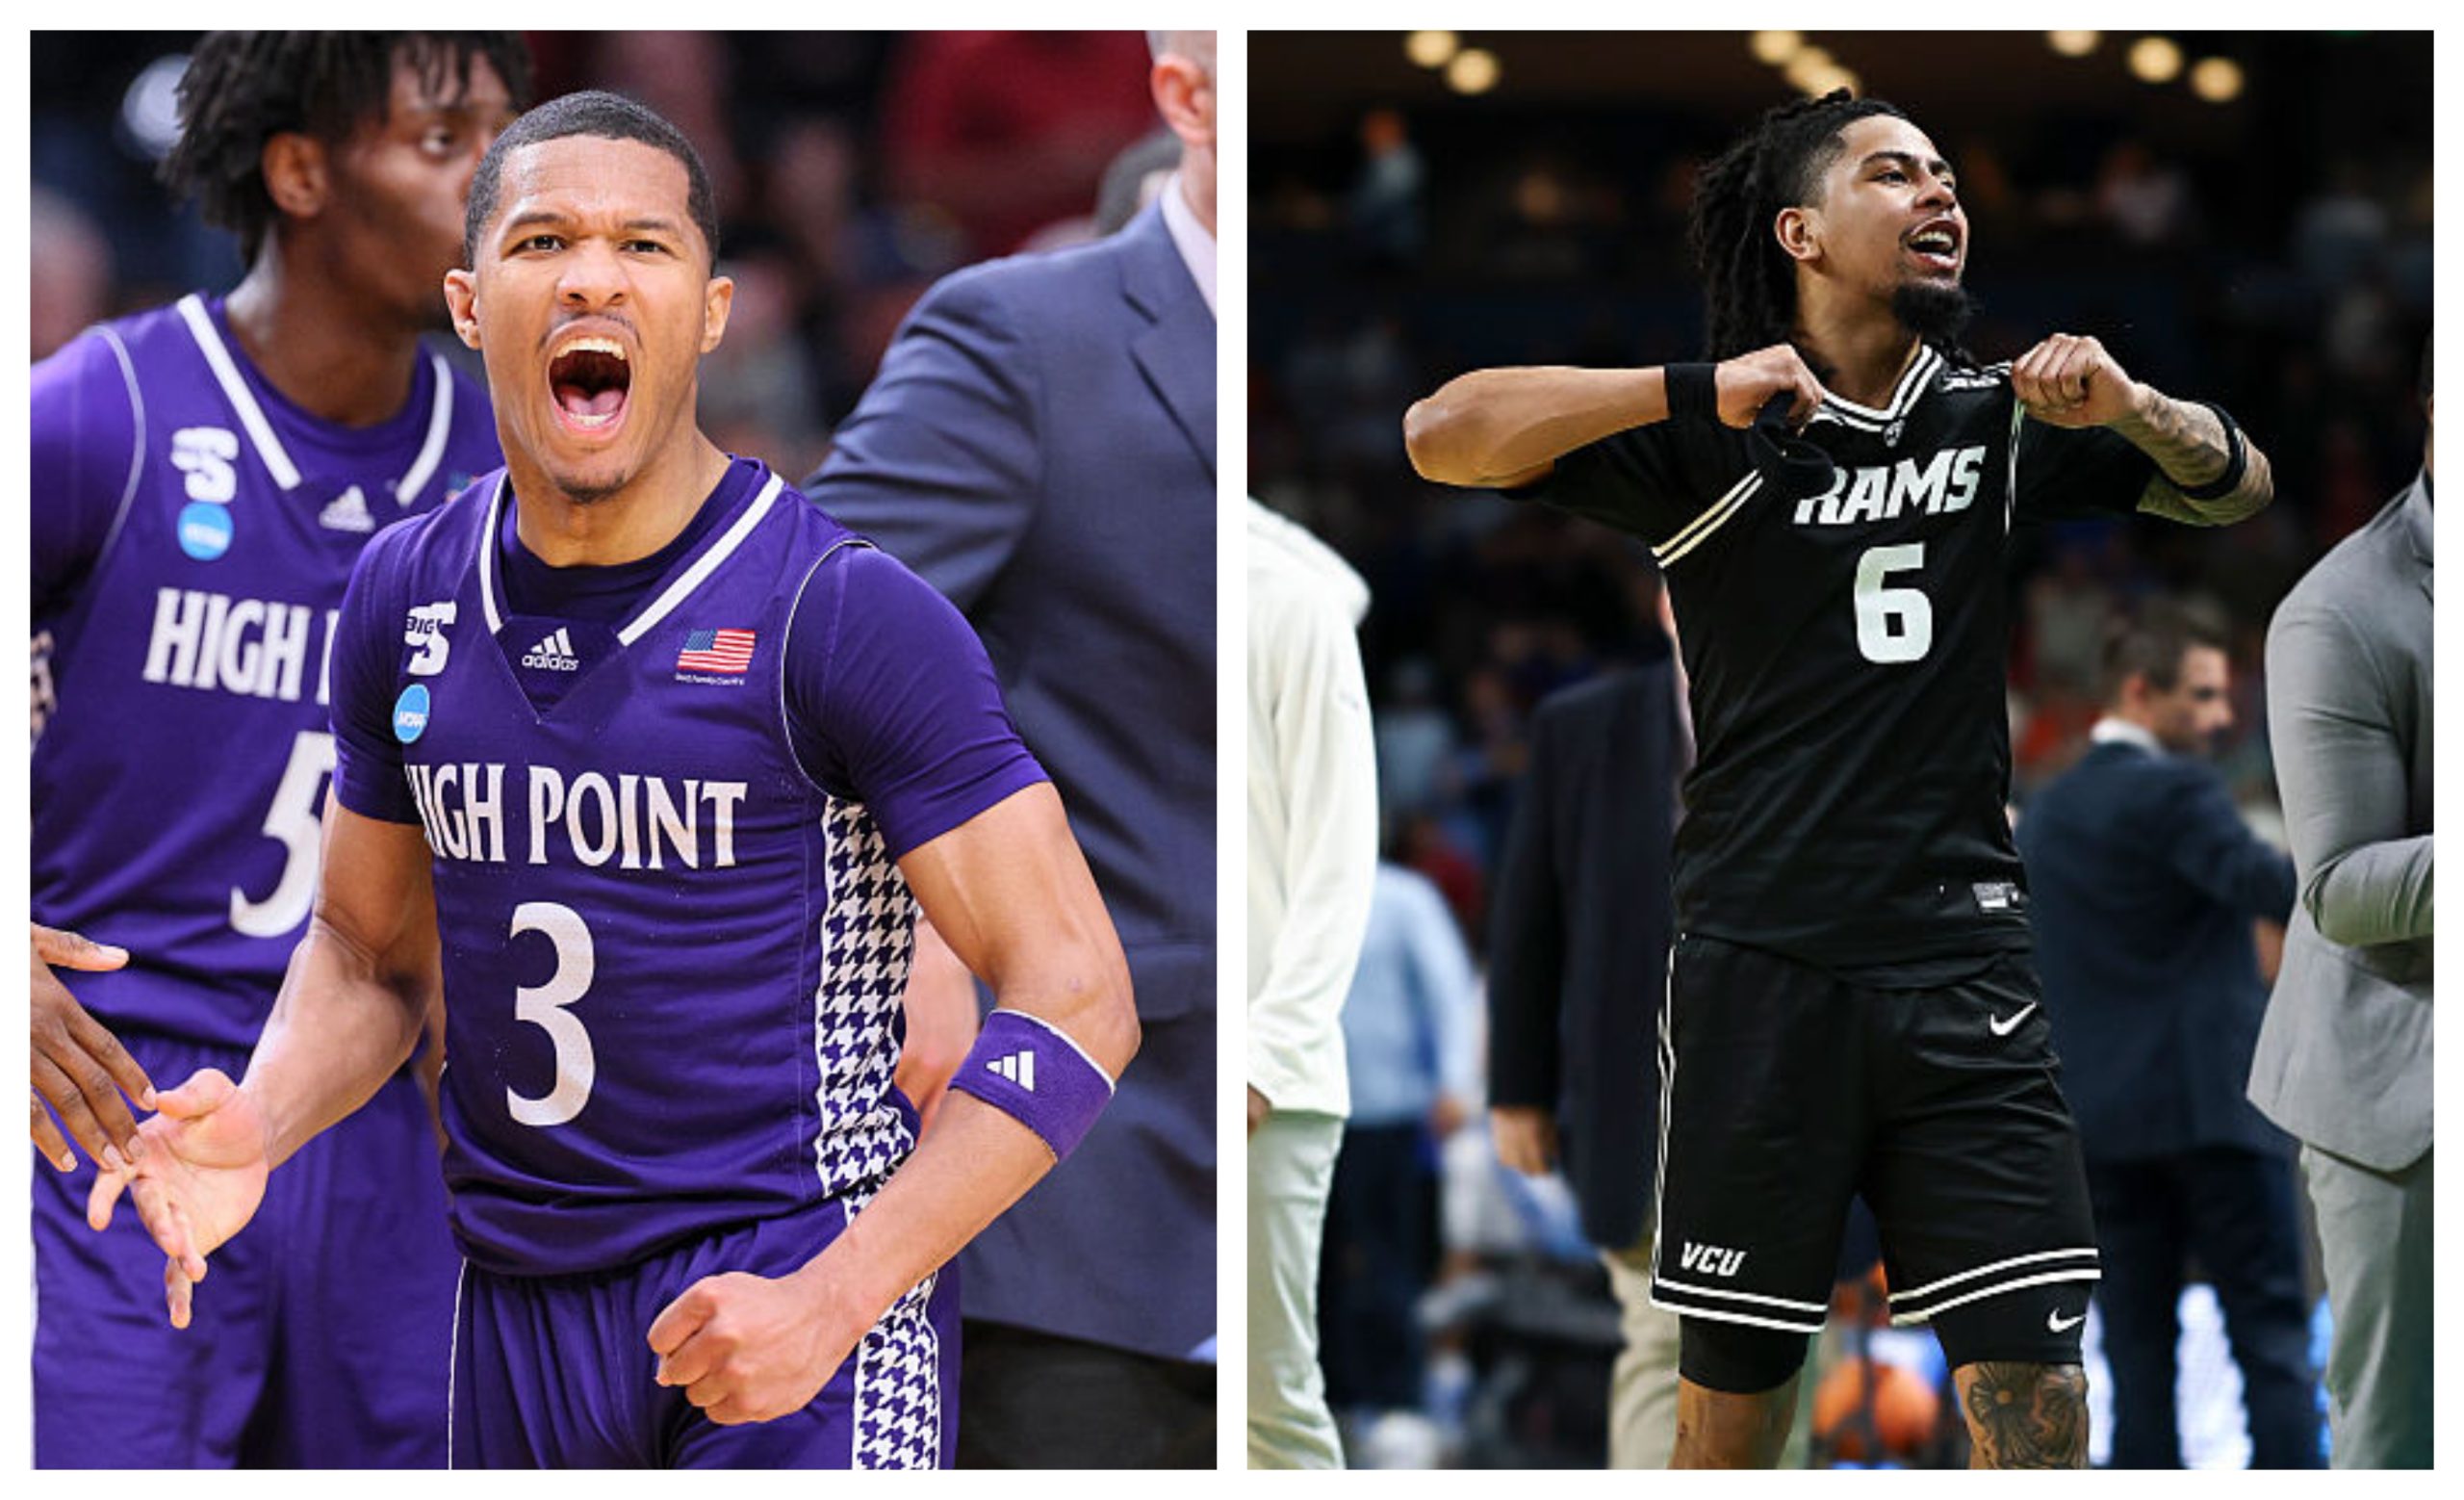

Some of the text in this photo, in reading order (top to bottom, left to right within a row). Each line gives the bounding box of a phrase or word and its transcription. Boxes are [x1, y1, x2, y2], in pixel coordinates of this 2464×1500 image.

[1793, 445, 1987, 525] RAMS
[143, 587, 311, 701] HIGH
[1854, 542, 1933, 664] 6
[522, 654, 579, 671] adidas
[230, 730, 338, 938] 5
[528, 765, 748, 869] POINT
[507, 901, 595, 1126] 3
[1681, 1241, 1746, 1277] VCU
